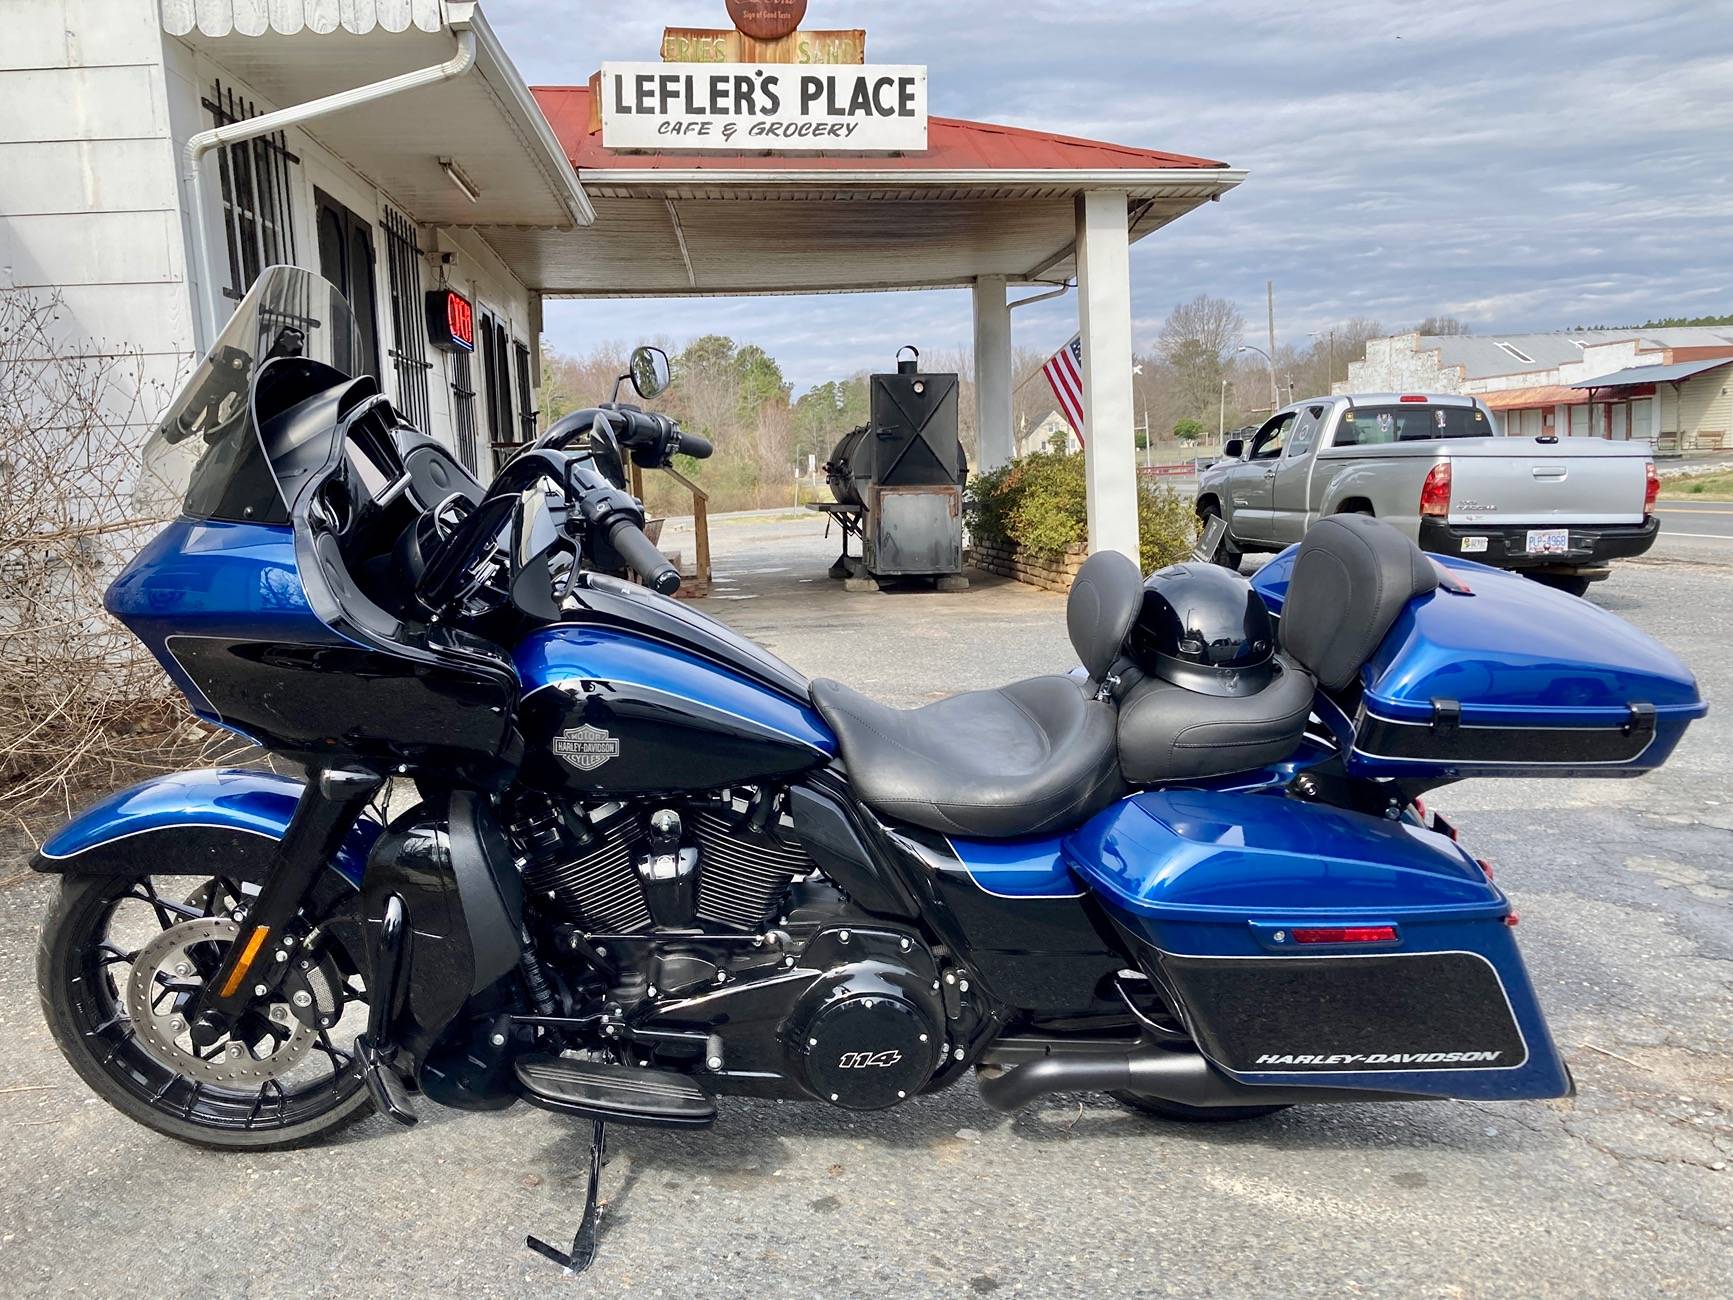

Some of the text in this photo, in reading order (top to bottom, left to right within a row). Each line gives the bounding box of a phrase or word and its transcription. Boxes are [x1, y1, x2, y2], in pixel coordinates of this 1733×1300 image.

[614, 69, 916, 117] LEFLER'S PLACE
[657, 121, 859, 142] CAFE & GROCERY
[570, 730, 602, 741] MOTOR
[558, 742, 615, 753] HARLEY-DAVIDSON
[570, 754, 602, 766] CYCLES
[839, 1050, 902, 1068] 114
[1255, 1051, 1503, 1064] HARLEY-DAVIDSON
